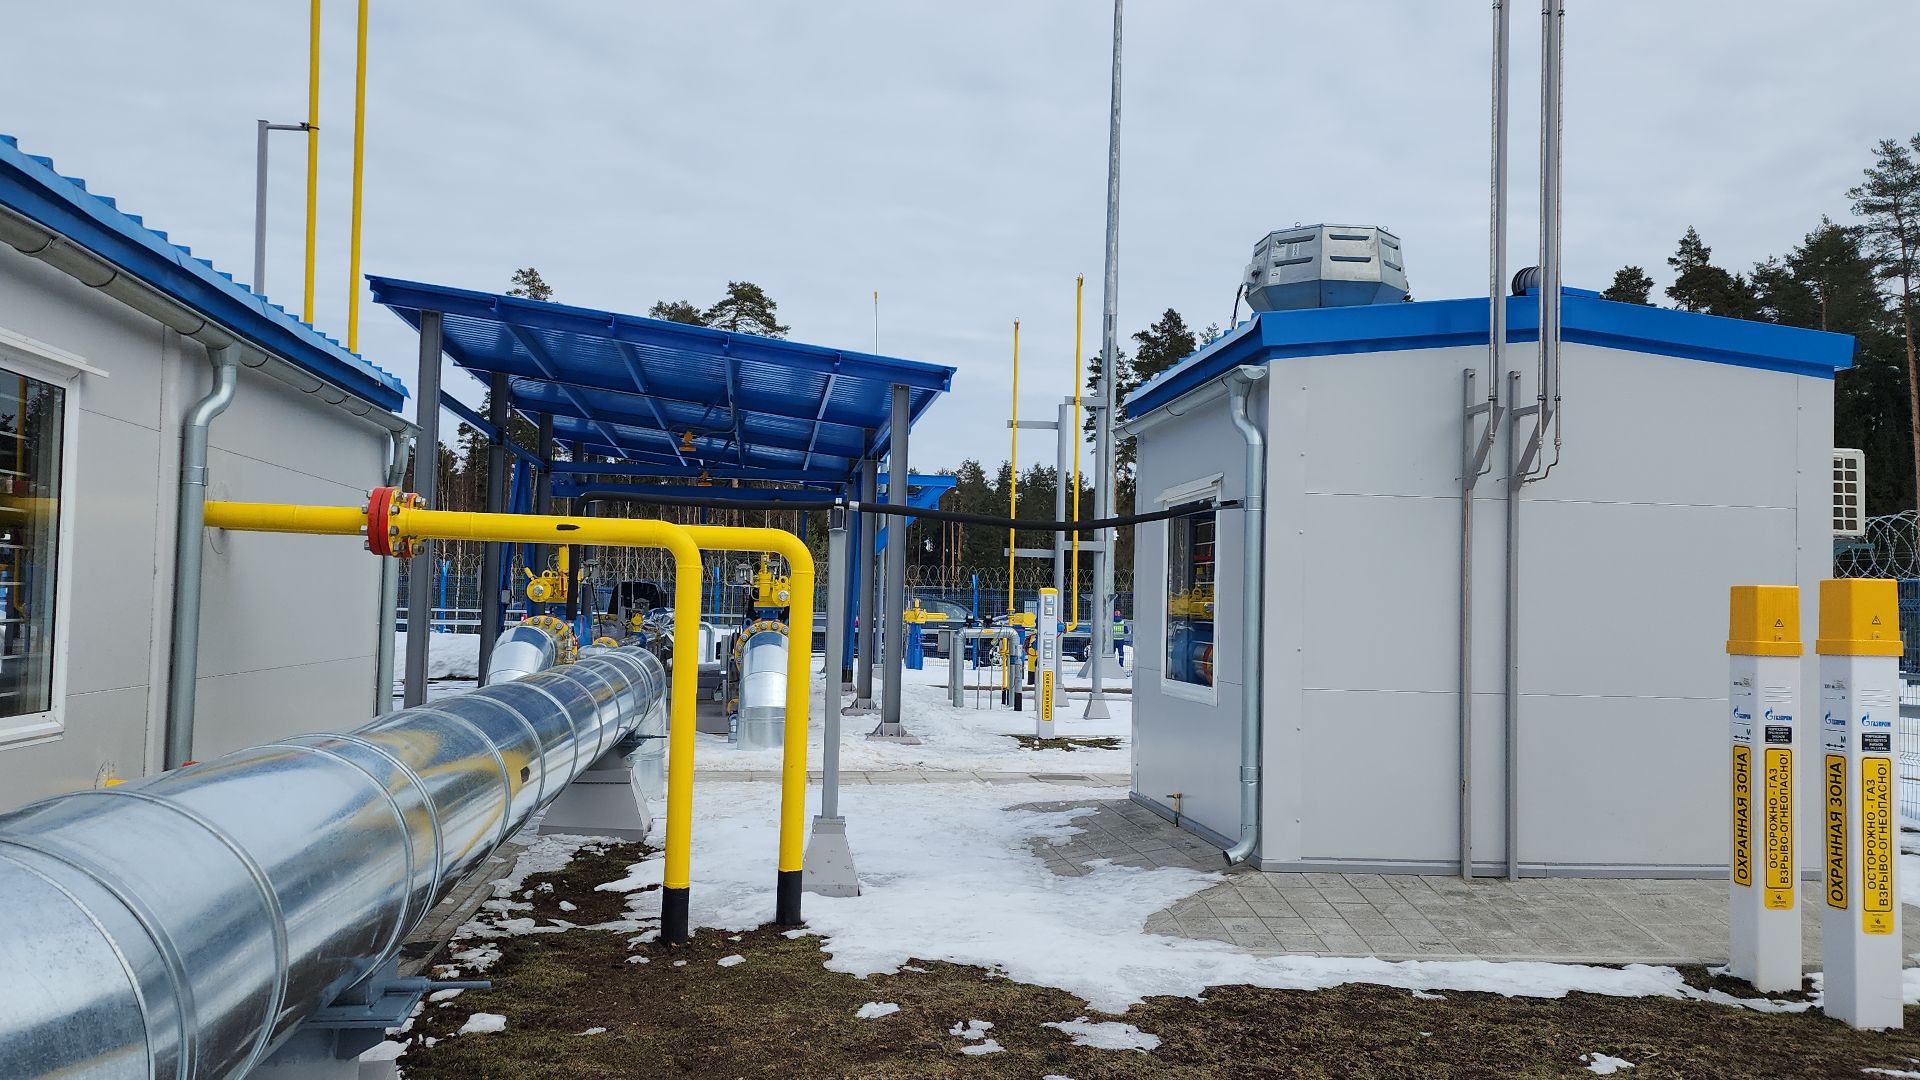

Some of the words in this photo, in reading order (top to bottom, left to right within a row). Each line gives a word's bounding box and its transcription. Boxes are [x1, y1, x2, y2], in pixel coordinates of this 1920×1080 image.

[1736, 752, 1748, 794] ЗОНА
[1769, 768, 1778, 789] ГАЗ
[1829, 762, 1843, 807] ЗОНА
[1866, 779, 1876, 802] ГАЗ
[1736, 797, 1748, 880] ОХРАННАЯ
[1769, 798, 1777, 869] ОСТОРОЖНО
[1779, 753, 1789, 884] ВЗРЫВО-ОГНЕОПАСНО!
[1866, 811, 1877, 890] ОСТОРОЖНО
[1877, 763, 1889, 907] ВЗРЫВО-ОГНЕОПАСНО!
[1830, 811, 1844, 902] ОХРАННАЯ
